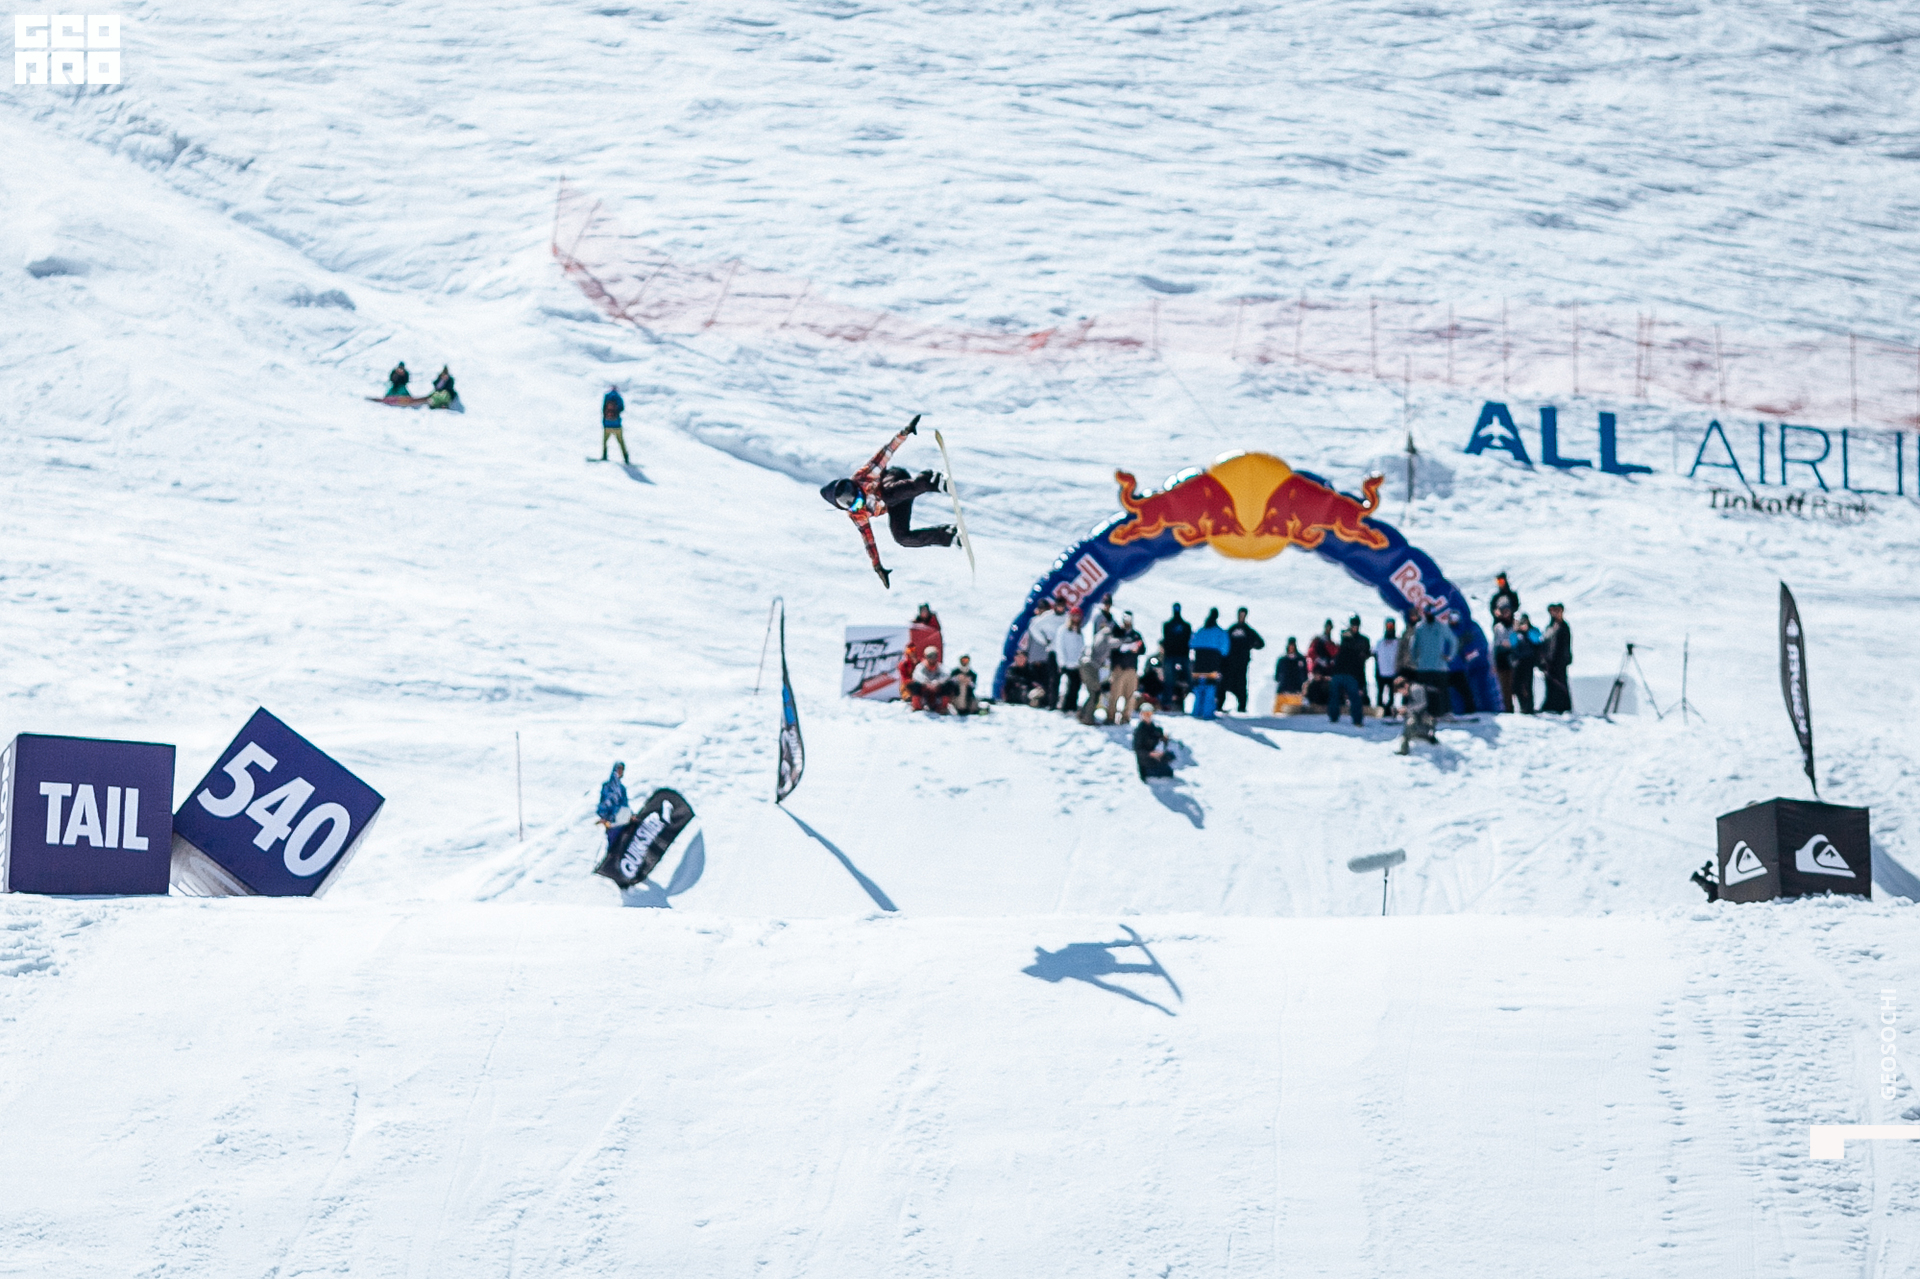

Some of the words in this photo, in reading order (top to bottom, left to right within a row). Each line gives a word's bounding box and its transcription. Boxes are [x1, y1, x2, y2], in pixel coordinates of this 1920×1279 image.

[1464, 401, 1653, 474] ALL
[1687, 419, 1920, 497] AIRLI
[1709, 488, 1806, 515] Tinkoff
[1053, 553, 1109, 608] Bull
[39, 782, 149, 851] TAIL
[197, 741, 351, 877] 540
